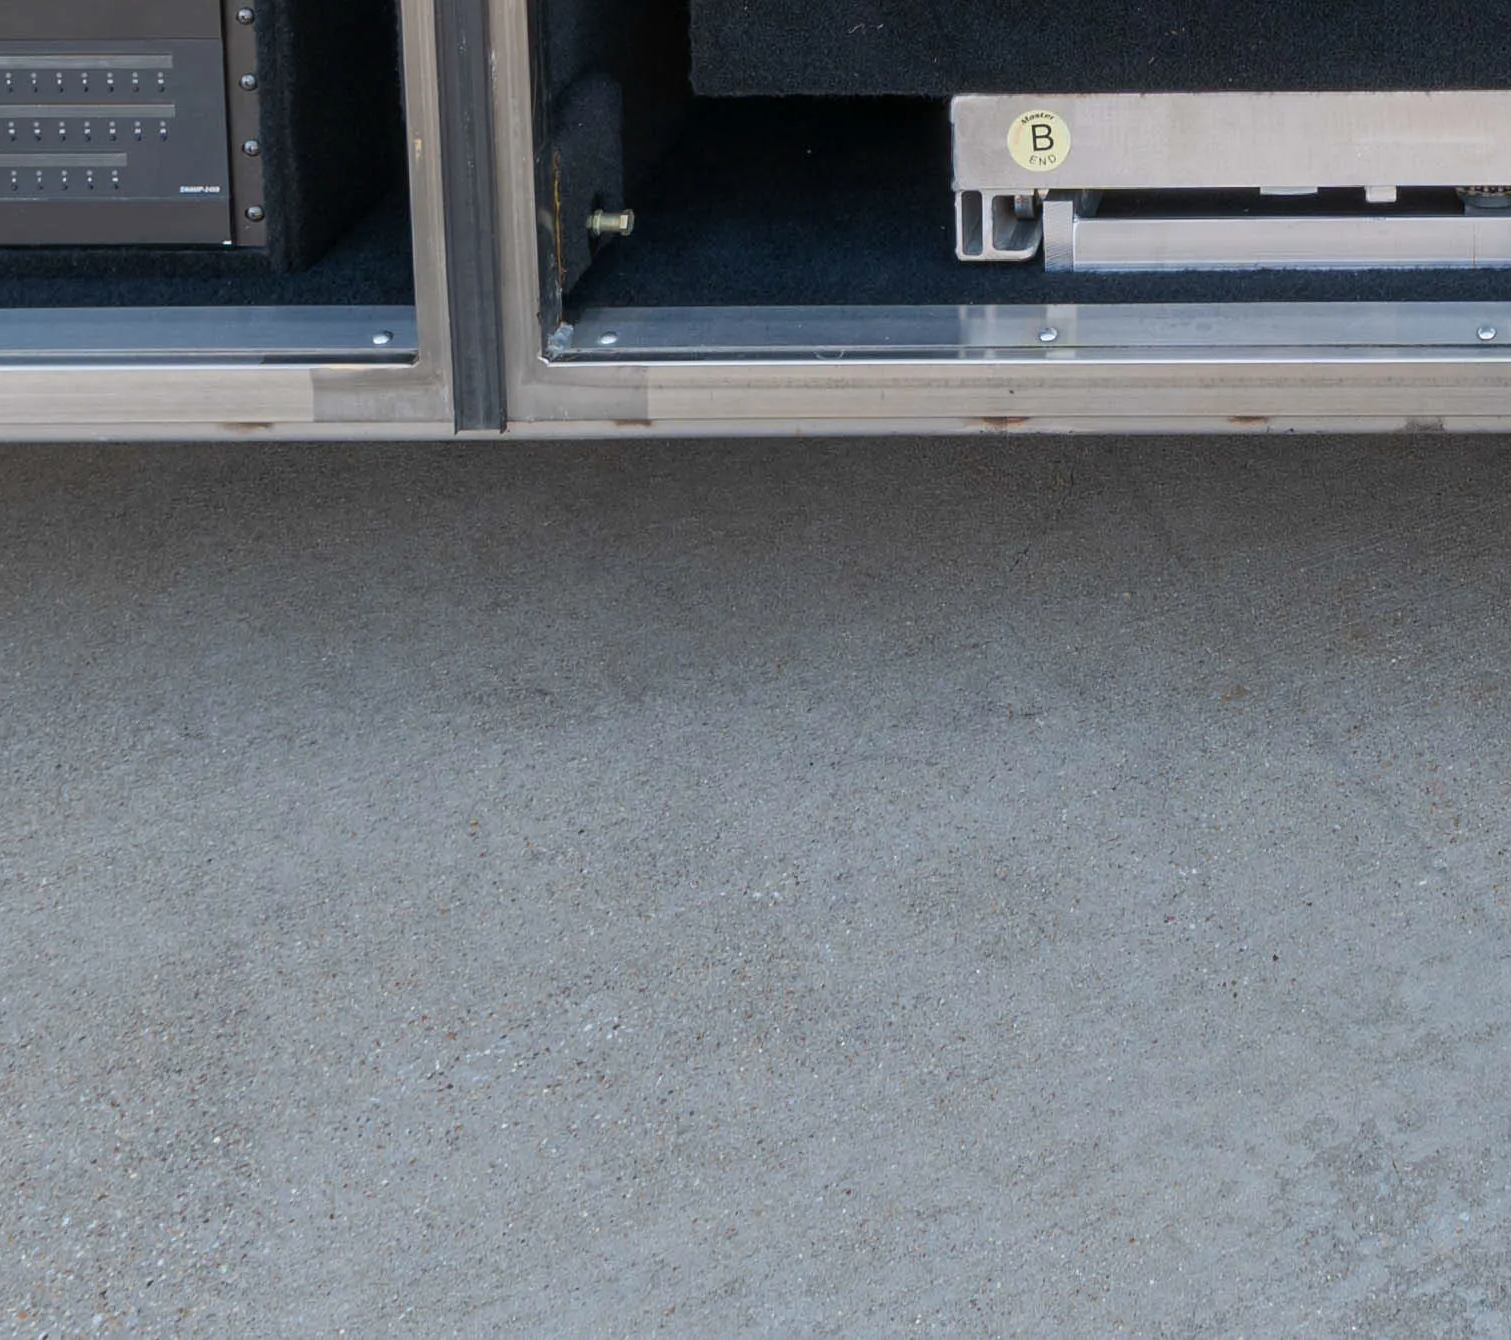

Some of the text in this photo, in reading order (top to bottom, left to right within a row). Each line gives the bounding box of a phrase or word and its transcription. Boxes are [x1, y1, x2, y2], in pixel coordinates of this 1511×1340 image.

[1021, 112, 1055, 126] Master
[1031, 123, 1055, 152] B
[1028, 154, 1057, 167] END
